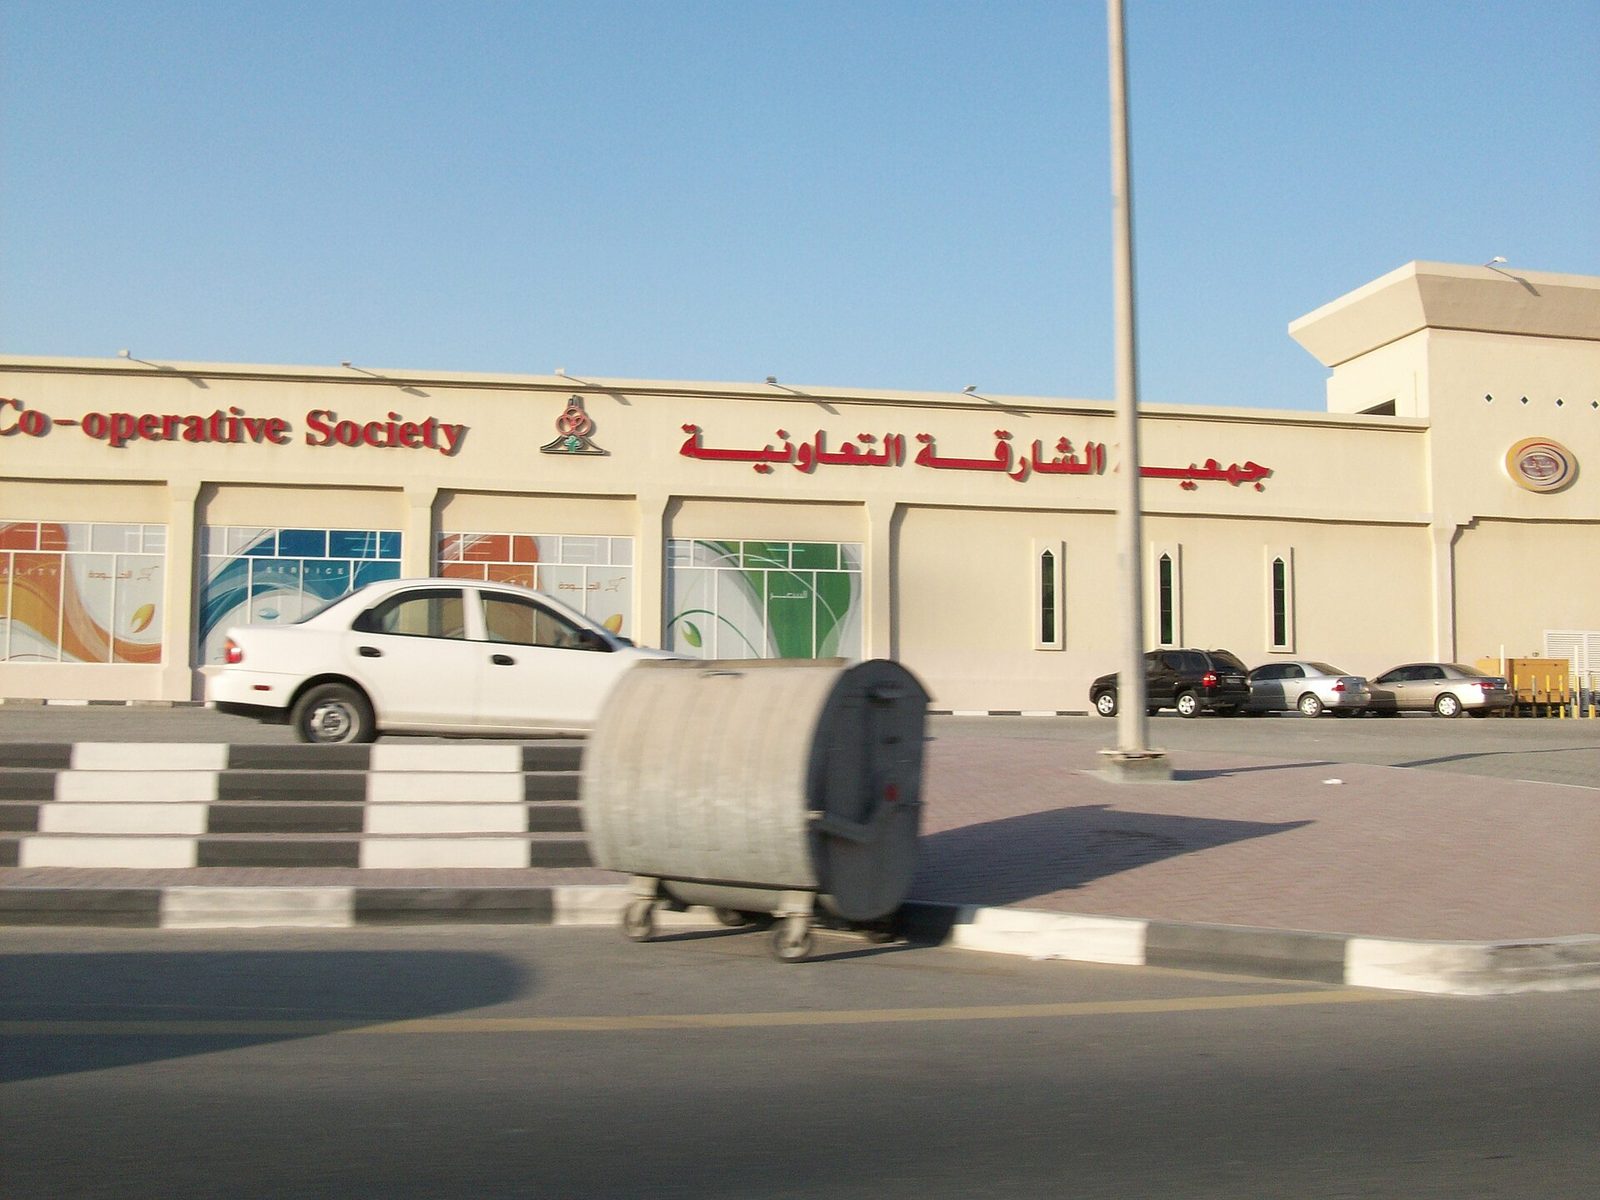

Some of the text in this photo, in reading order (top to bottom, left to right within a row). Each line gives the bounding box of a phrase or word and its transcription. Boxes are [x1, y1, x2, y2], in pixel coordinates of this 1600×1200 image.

[305, 409, 466, 456] Society
[680, 423, 1272, 492] جمعي الشارقة التعاونية
[266, 566, 345, 575] SERVICE
